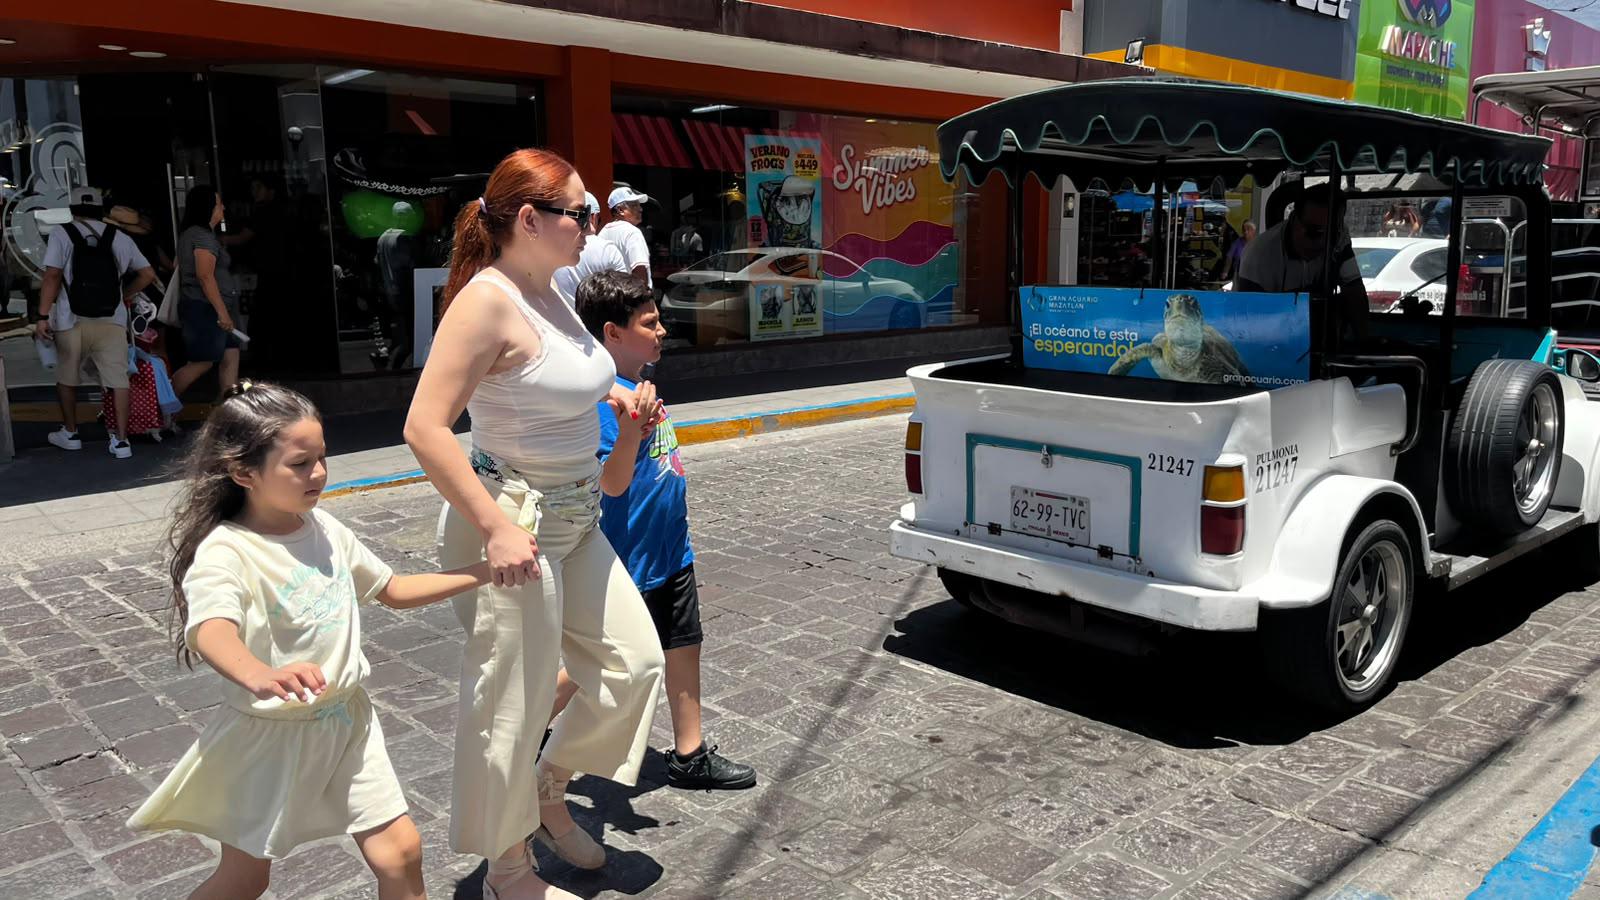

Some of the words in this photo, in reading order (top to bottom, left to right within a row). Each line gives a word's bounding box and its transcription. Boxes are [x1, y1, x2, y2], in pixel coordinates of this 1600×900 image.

[1380, 24, 1457, 69] MAPACHE
[751, 145, 790, 158] VERANO
[794, 159, 818, 170] $449
[833, 144, 929, 190] Summer
[854, 171, 916, 214] Vibes
[1067, 296, 1099, 304] ACUARIO
[1029, 323, 1042, 337] ¡El
[1044, 324, 1091, 339] océano
[1093, 326, 1107, 339] te
[1109, 328, 1139, 341] esta
[1148, 452, 1195, 477] 21247
[1256, 443, 1299, 464] PULMONIA
[1255, 456, 1299, 494] 21247
[1013, 499, 1086, 530] 62-99-TVC
